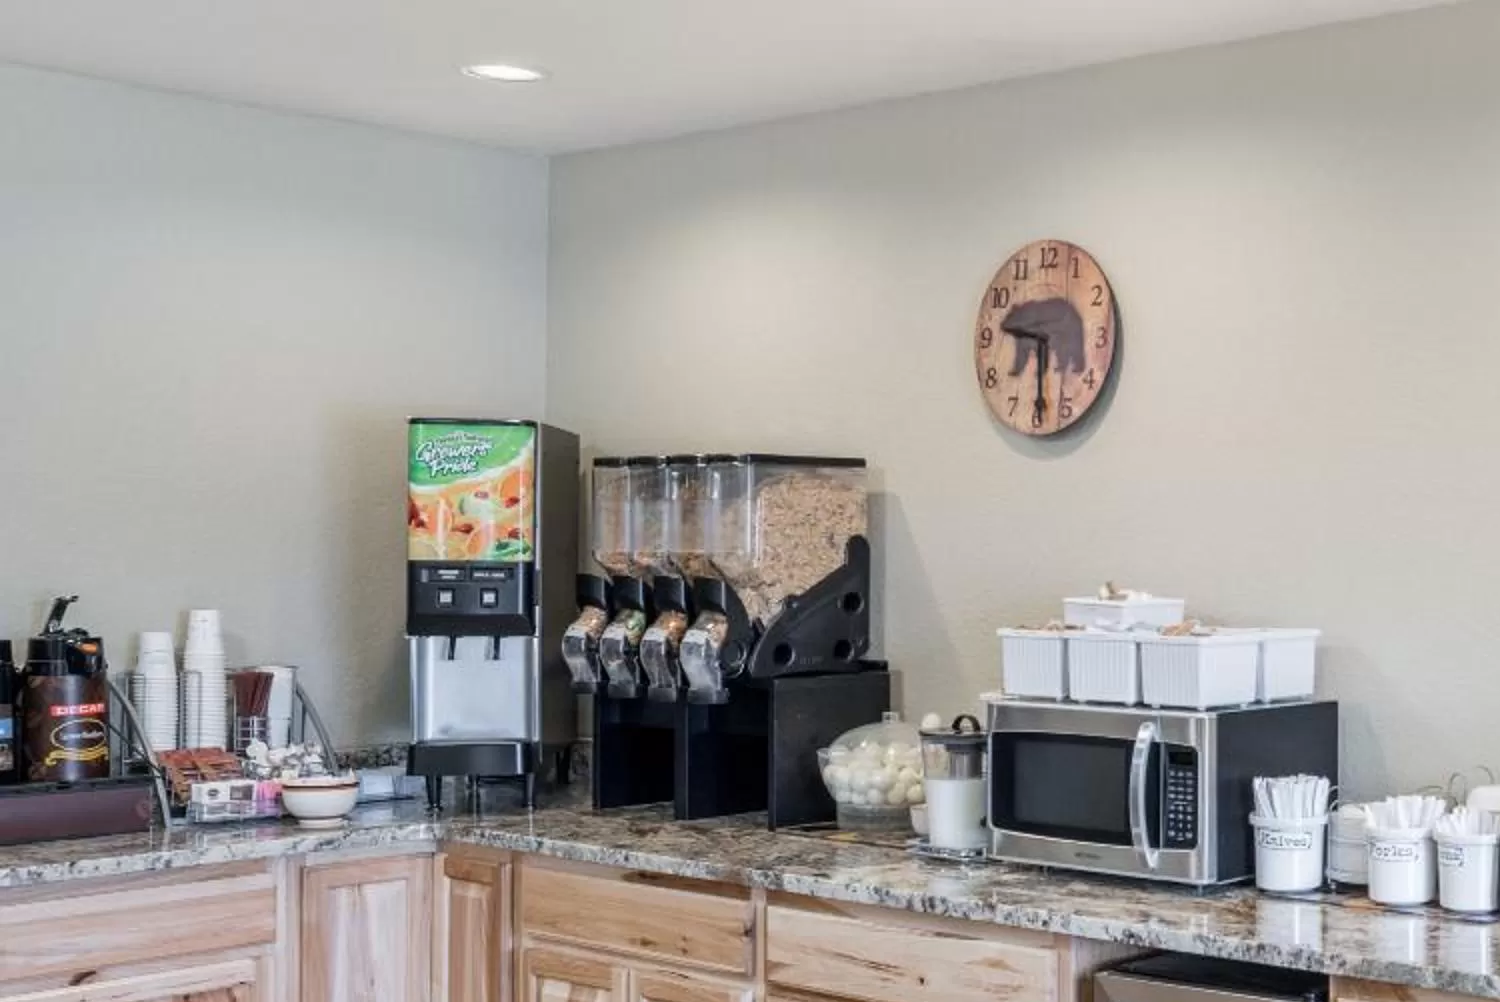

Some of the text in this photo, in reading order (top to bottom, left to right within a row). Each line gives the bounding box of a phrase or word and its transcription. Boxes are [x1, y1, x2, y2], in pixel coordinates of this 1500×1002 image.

[1040, 247, 1059, 269] 12
[1072, 257, 1081, 279] 1
[1013, 259, 1028, 281] 11
[991, 287, 1010, 309] 10
[1091, 285, 1103, 307] 2
[980, 327, 993, 349] 9
[1095, 326, 1107, 349] 3
[985, 367, 997, 389] 8
[1082, 368, 1095, 390] 4
[1007, 397, 1019, 417] 7
[1059, 397, 1073, 419] 5
